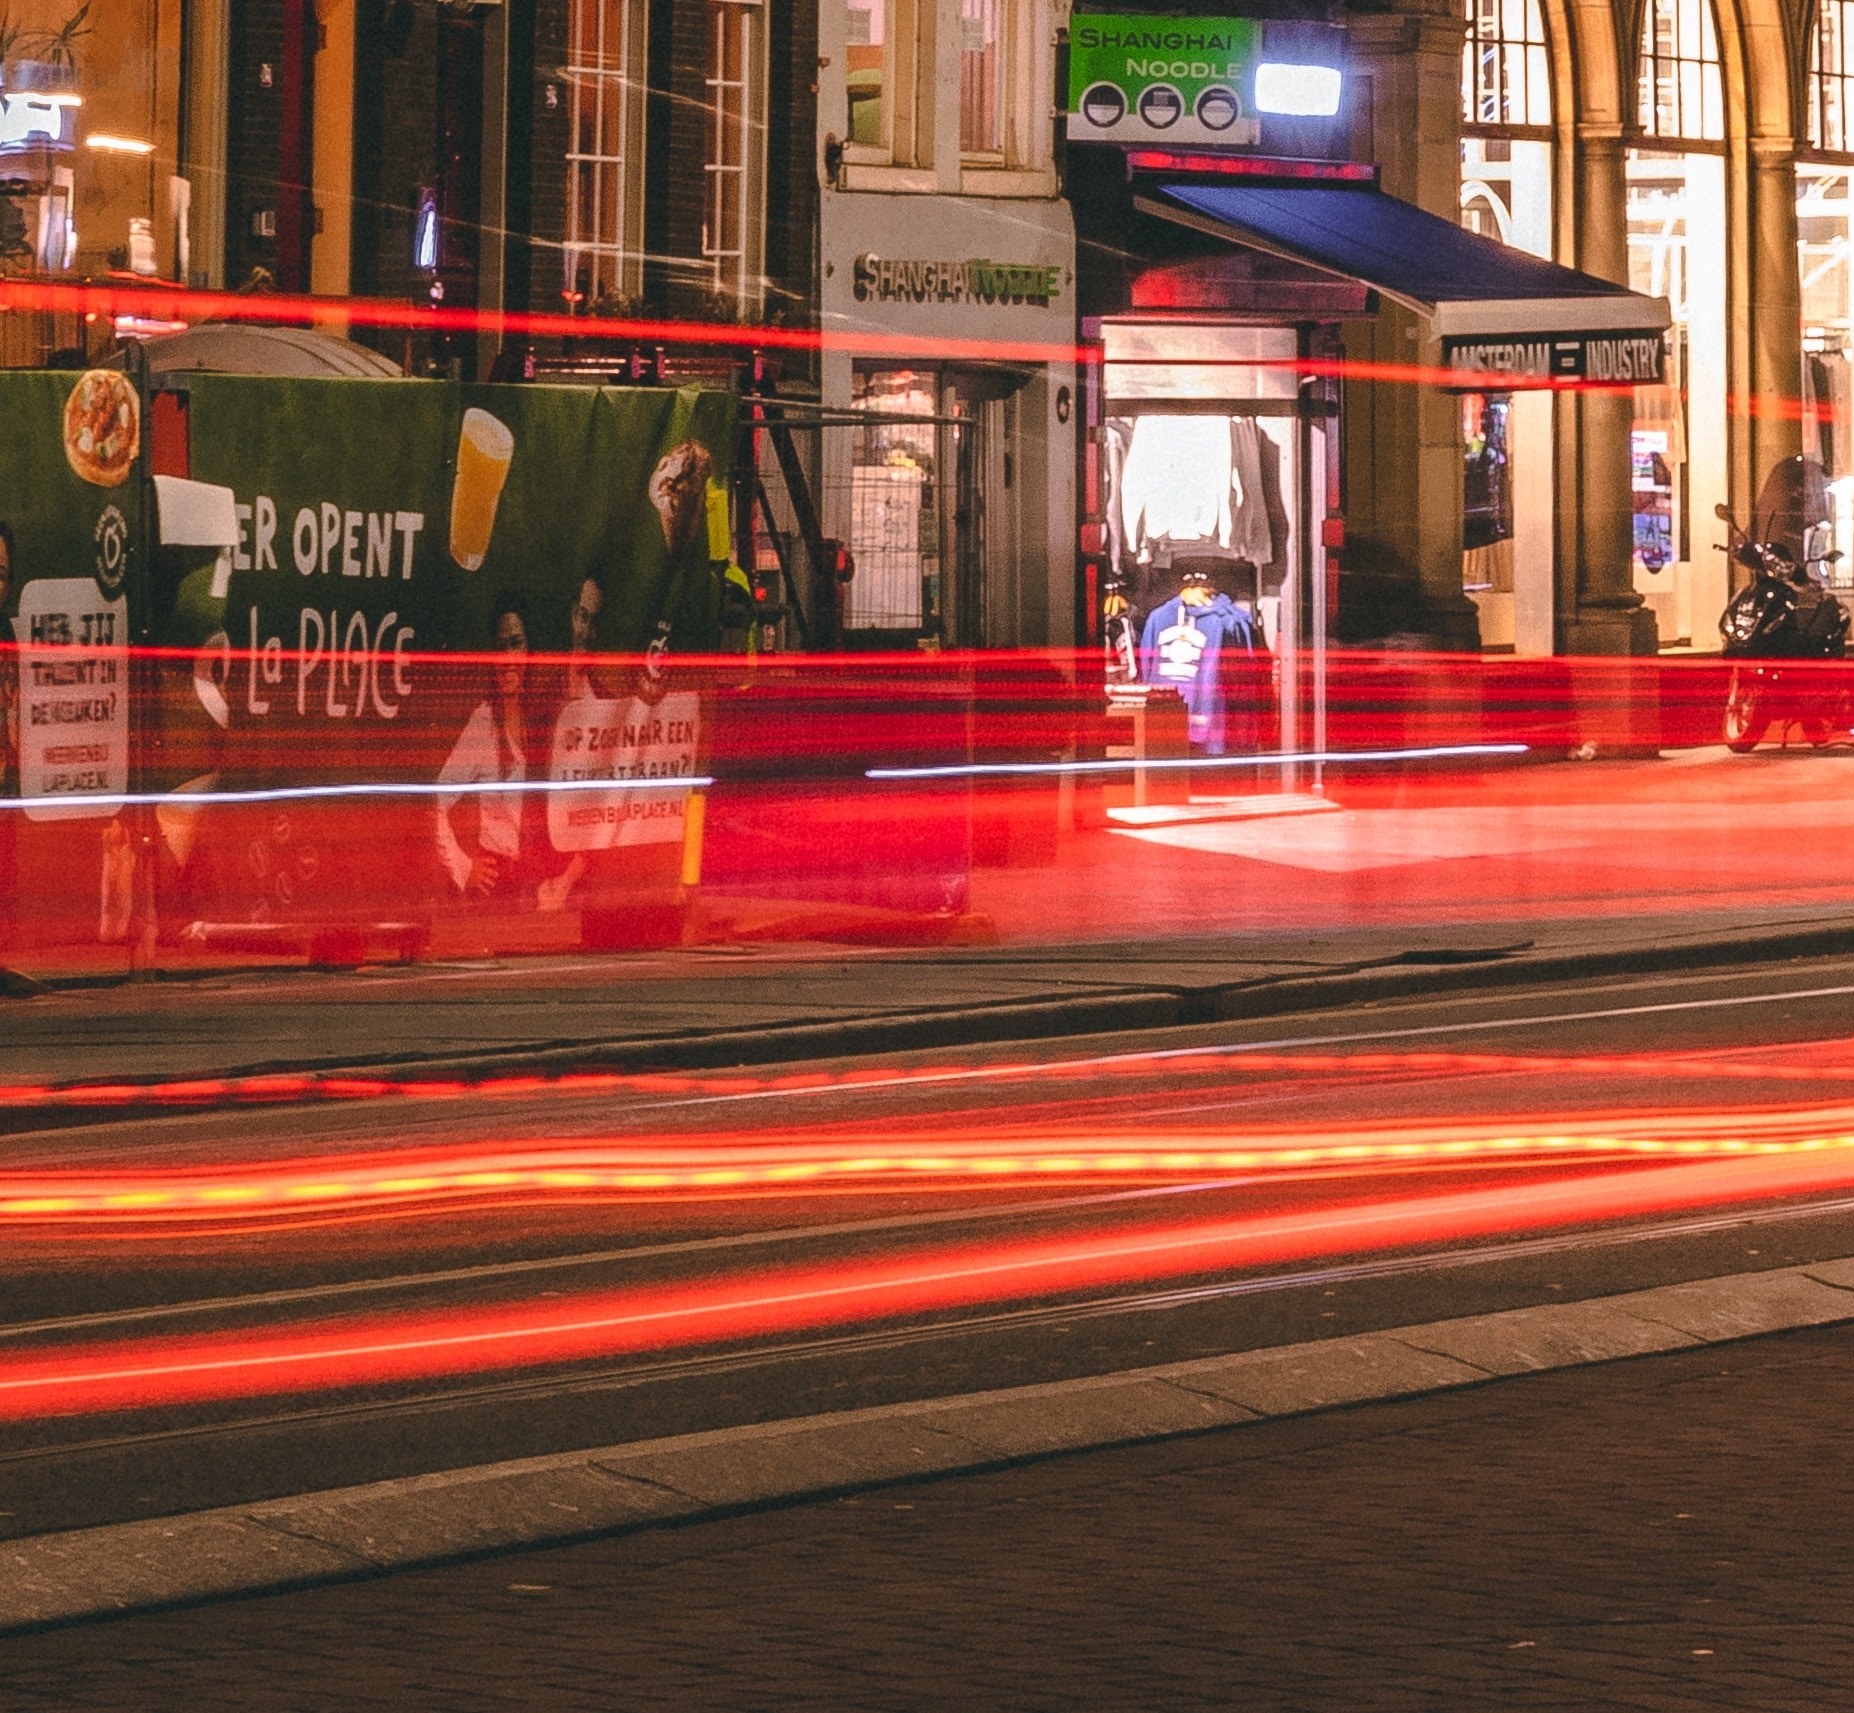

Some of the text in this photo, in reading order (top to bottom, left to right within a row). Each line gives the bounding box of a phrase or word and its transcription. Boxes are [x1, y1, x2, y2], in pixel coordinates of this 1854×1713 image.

[1079, 27, 1233, 51] SHANGHAI
[1125, 58, 1243, 79] NOODLE
[1450, 338, 1660, 381] AMSTERDAM INDUSTRY
[293, 501, 425, 580] OPENT
